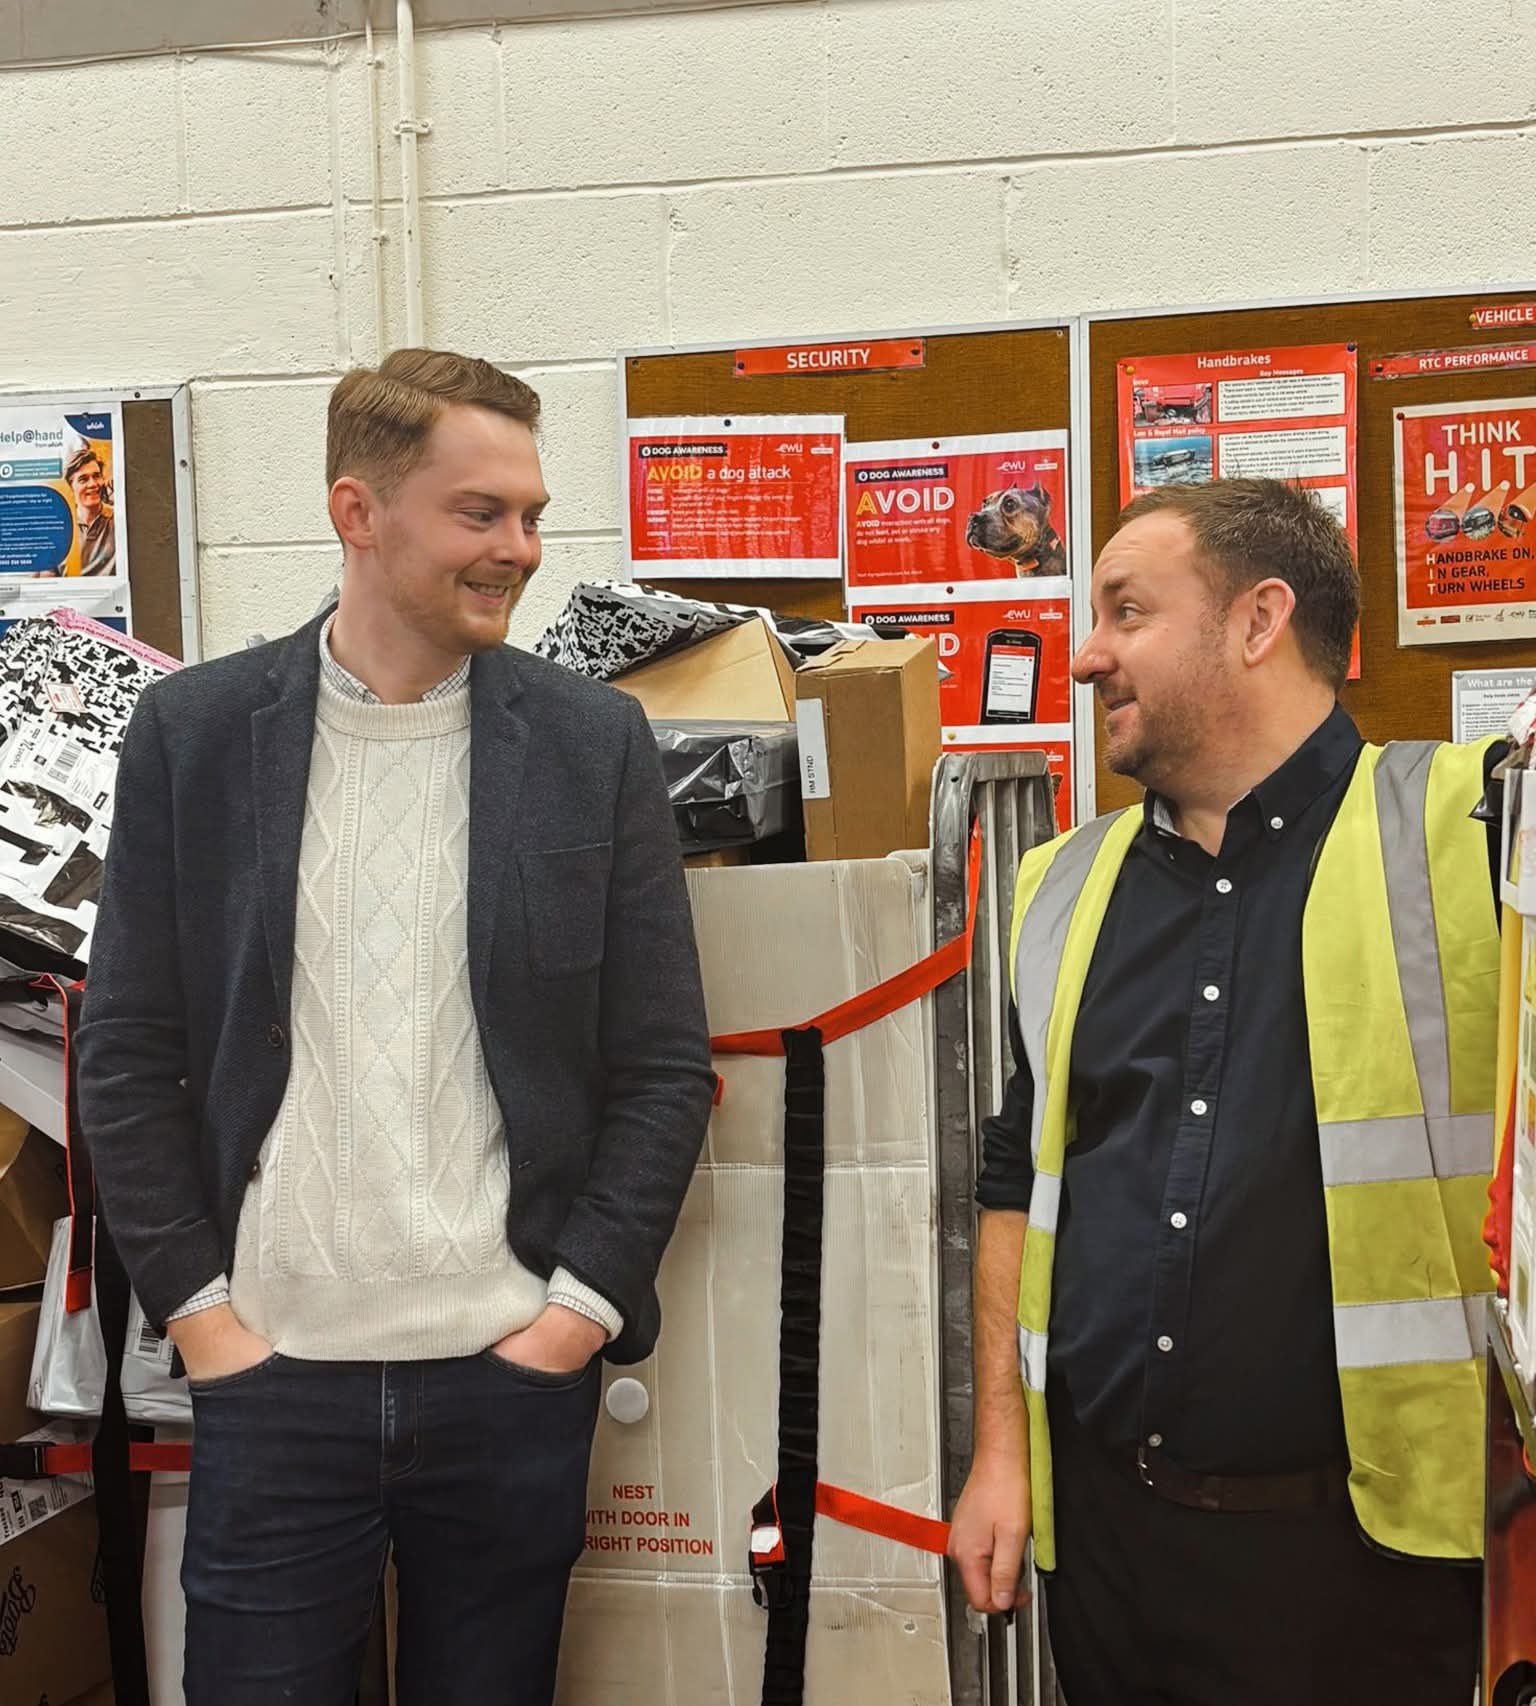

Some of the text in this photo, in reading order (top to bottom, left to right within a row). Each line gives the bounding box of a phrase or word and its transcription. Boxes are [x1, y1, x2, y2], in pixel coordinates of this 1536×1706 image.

[1476, 308, 1534, 324] VEHICLE
[786, 349, 871, 369] SECURITY
[1197, 354, 1272, 369] Handbrakes
[1419, 349, 1529, 369] RTC PERFORMANCE
[1441, 420, 1522, 446] THINK
[652, 446, 724, 455] DOG AWARENESS
[648, 464, 791, 482] AVOID a dog attack
[869, 467, 945, 480] DOG AWARENESS
[856, 486, 955, 515] AVOID
[1426, 548, 1507, 566] HANDBRAKE
[1427, 578, 1526, 595] TURN WHEELS
[876, 613, 950, 624] DOG AWARENESS
[1467, 679, 1495, 688] What
[1516, 676, 1533, 687] the
[612, 1485, 655, 1500] NEST
[621, 1511, 670, 1527] DOOR
[674, 1511, 690, 1527] IN
[584, 1535, 713, 1554] RIGHT POSITION
